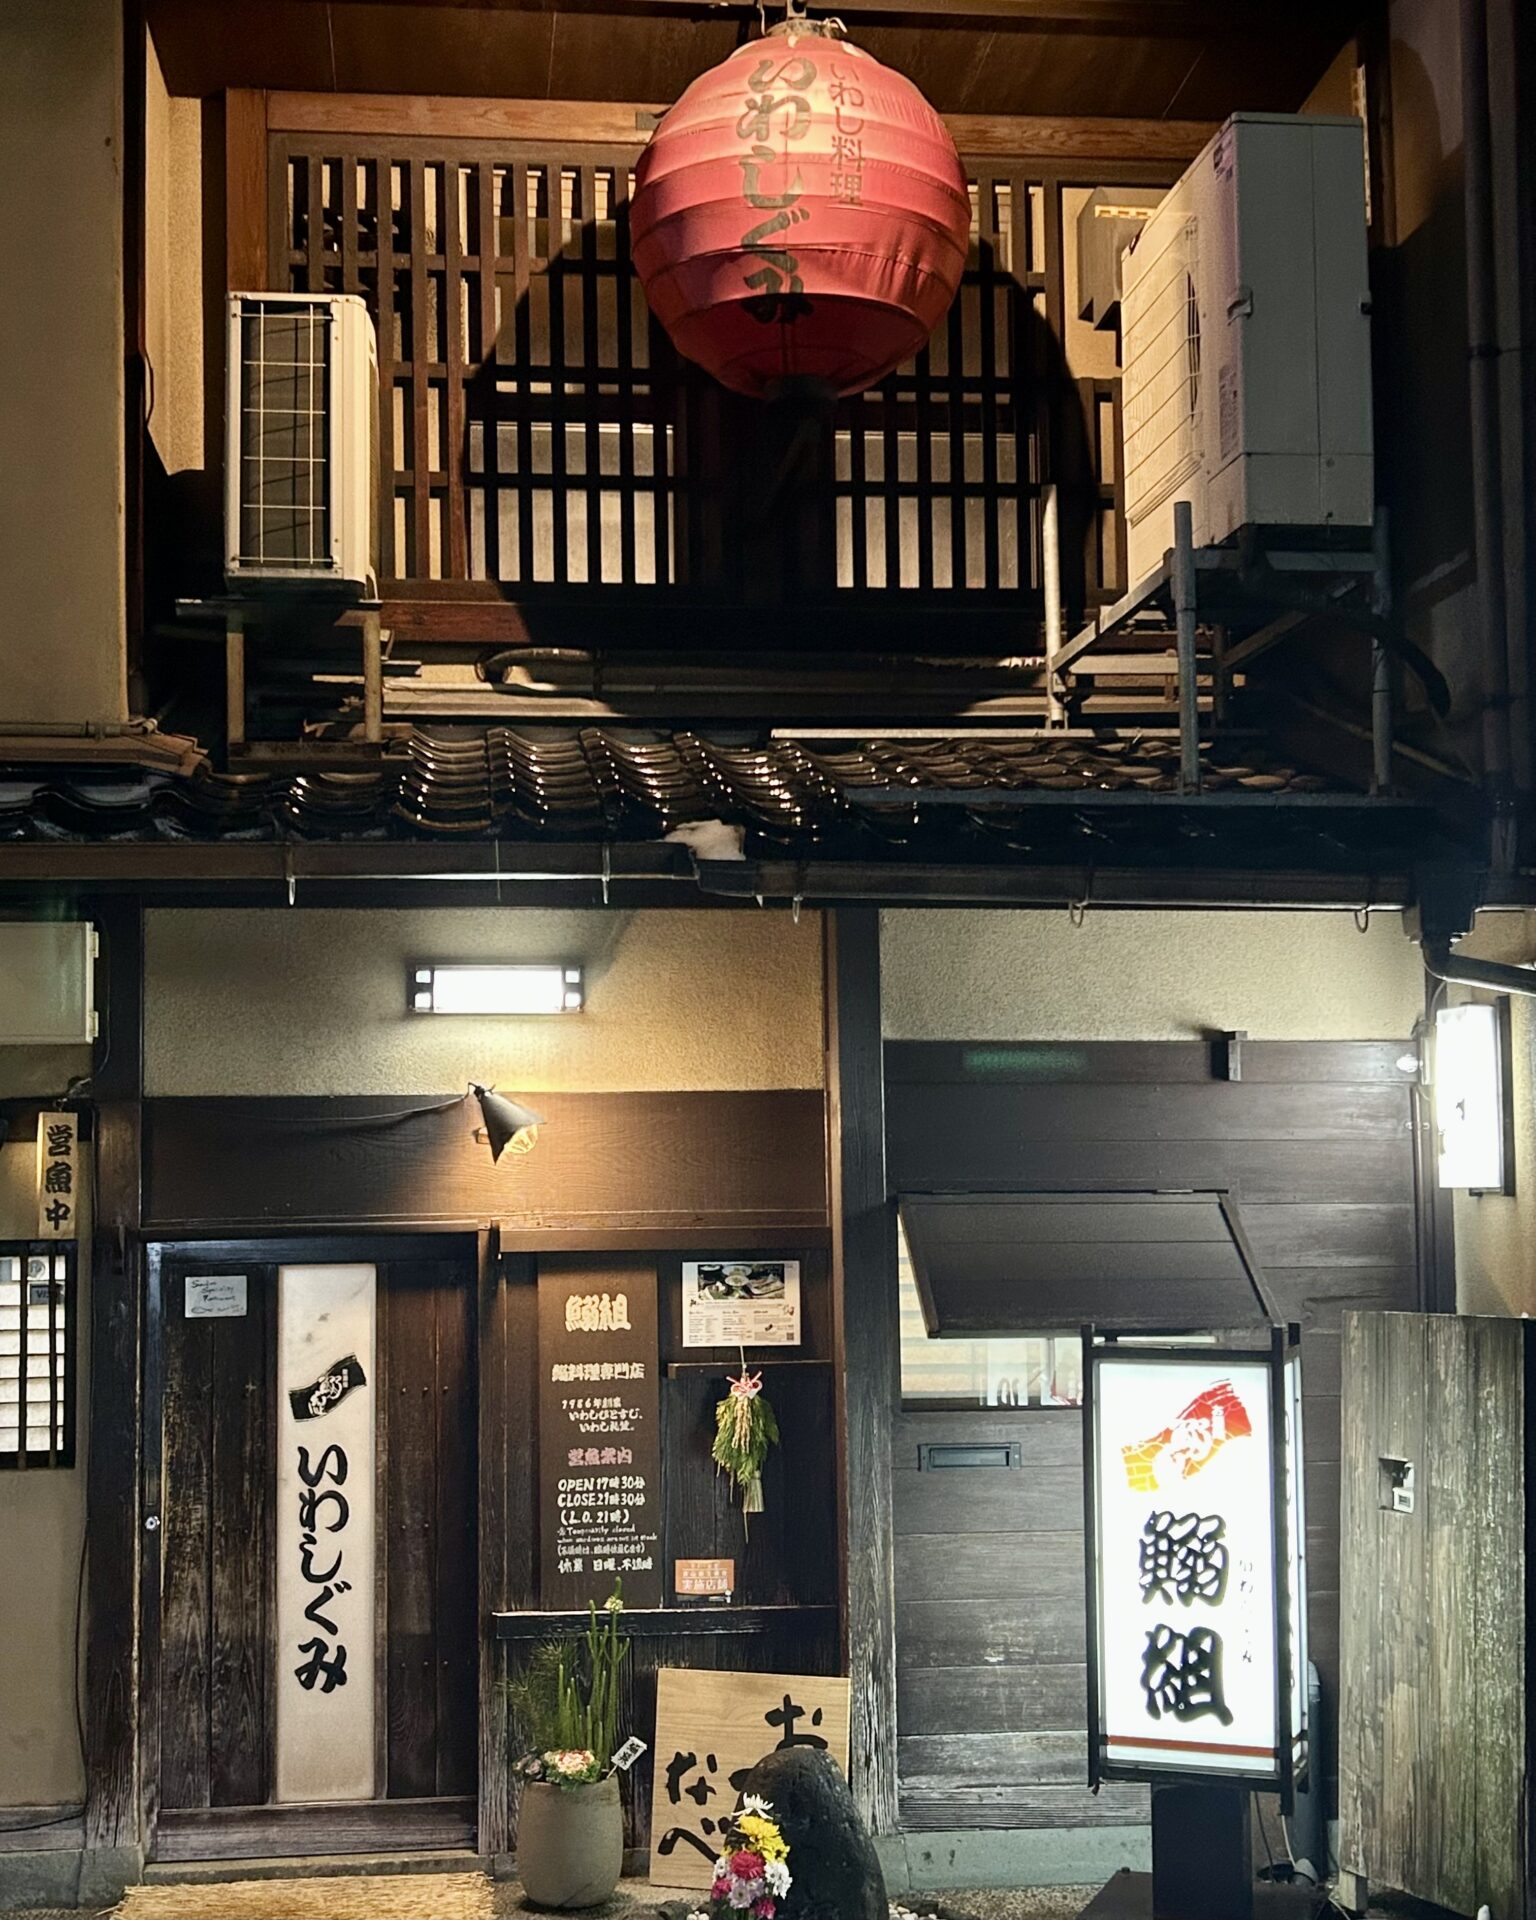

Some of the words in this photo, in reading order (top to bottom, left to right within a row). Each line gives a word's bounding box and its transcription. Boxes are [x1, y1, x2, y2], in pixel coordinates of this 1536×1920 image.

[829, 63, 866, 207] いわし料理
[295, 1444, 352, 1693] いわしぐみ
[1139, 1510, 1234, 1727] 鰯組
